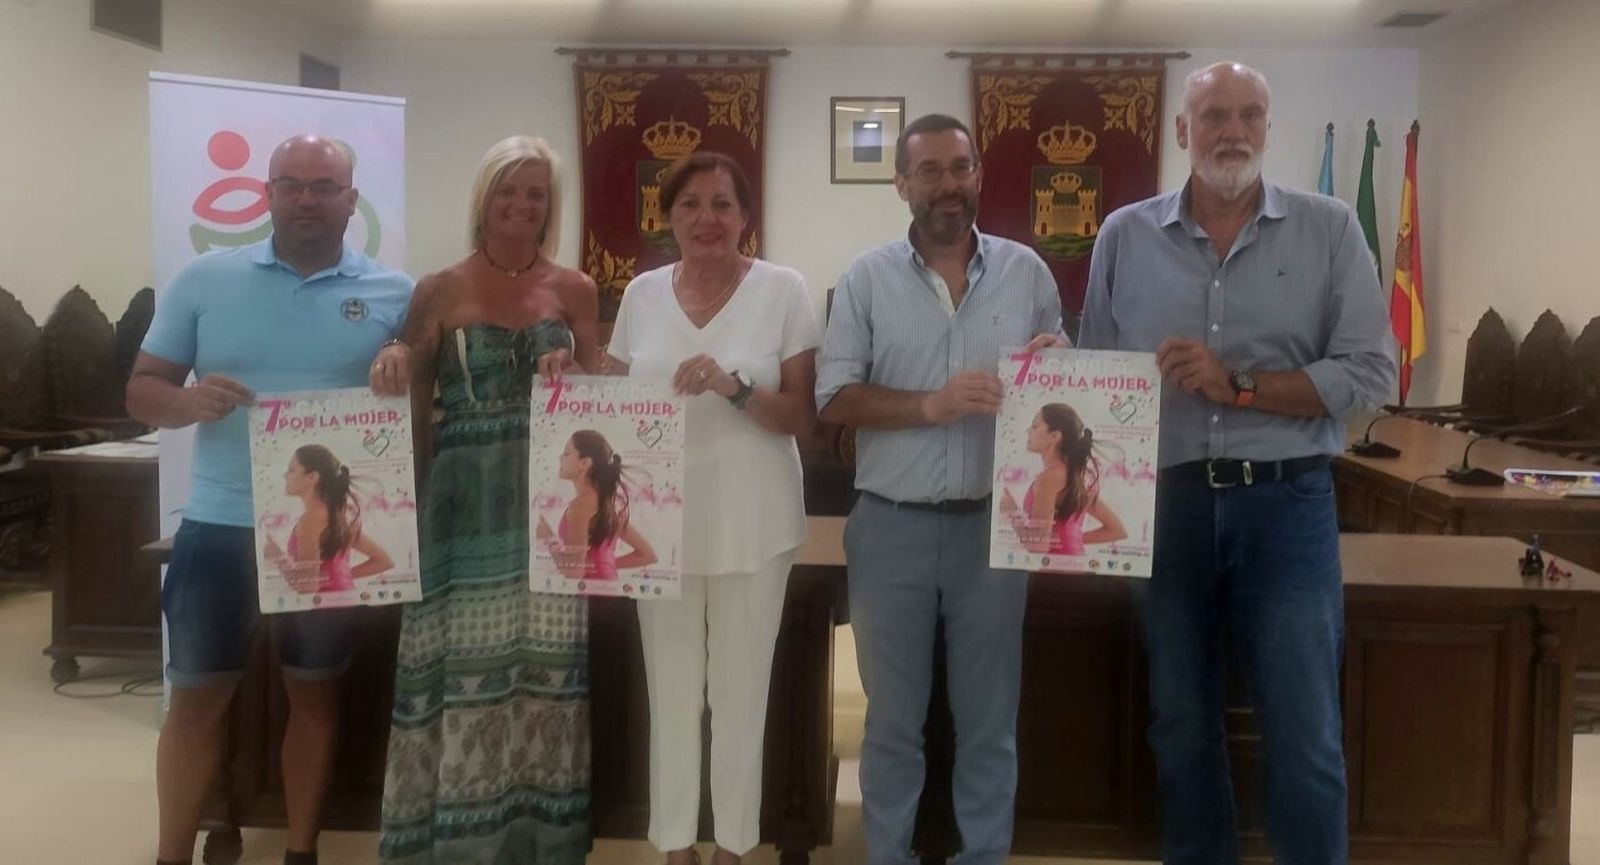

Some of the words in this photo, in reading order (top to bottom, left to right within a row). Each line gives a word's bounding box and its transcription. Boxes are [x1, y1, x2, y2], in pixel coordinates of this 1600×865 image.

[1027, 373, 1064, 387] POR
[1068, 375, 1088, 388] LA
[1092, 374, 1149, 391] MUJER
[559, 400, 591, 414] POR
[597, 401, 616, 414] LA
[621, 400, 674, 415] MUJER
[278, 415, 315, 429] POR
[319, 414, 340, 427] LA
[344, 409, 399, 426] MUJER
